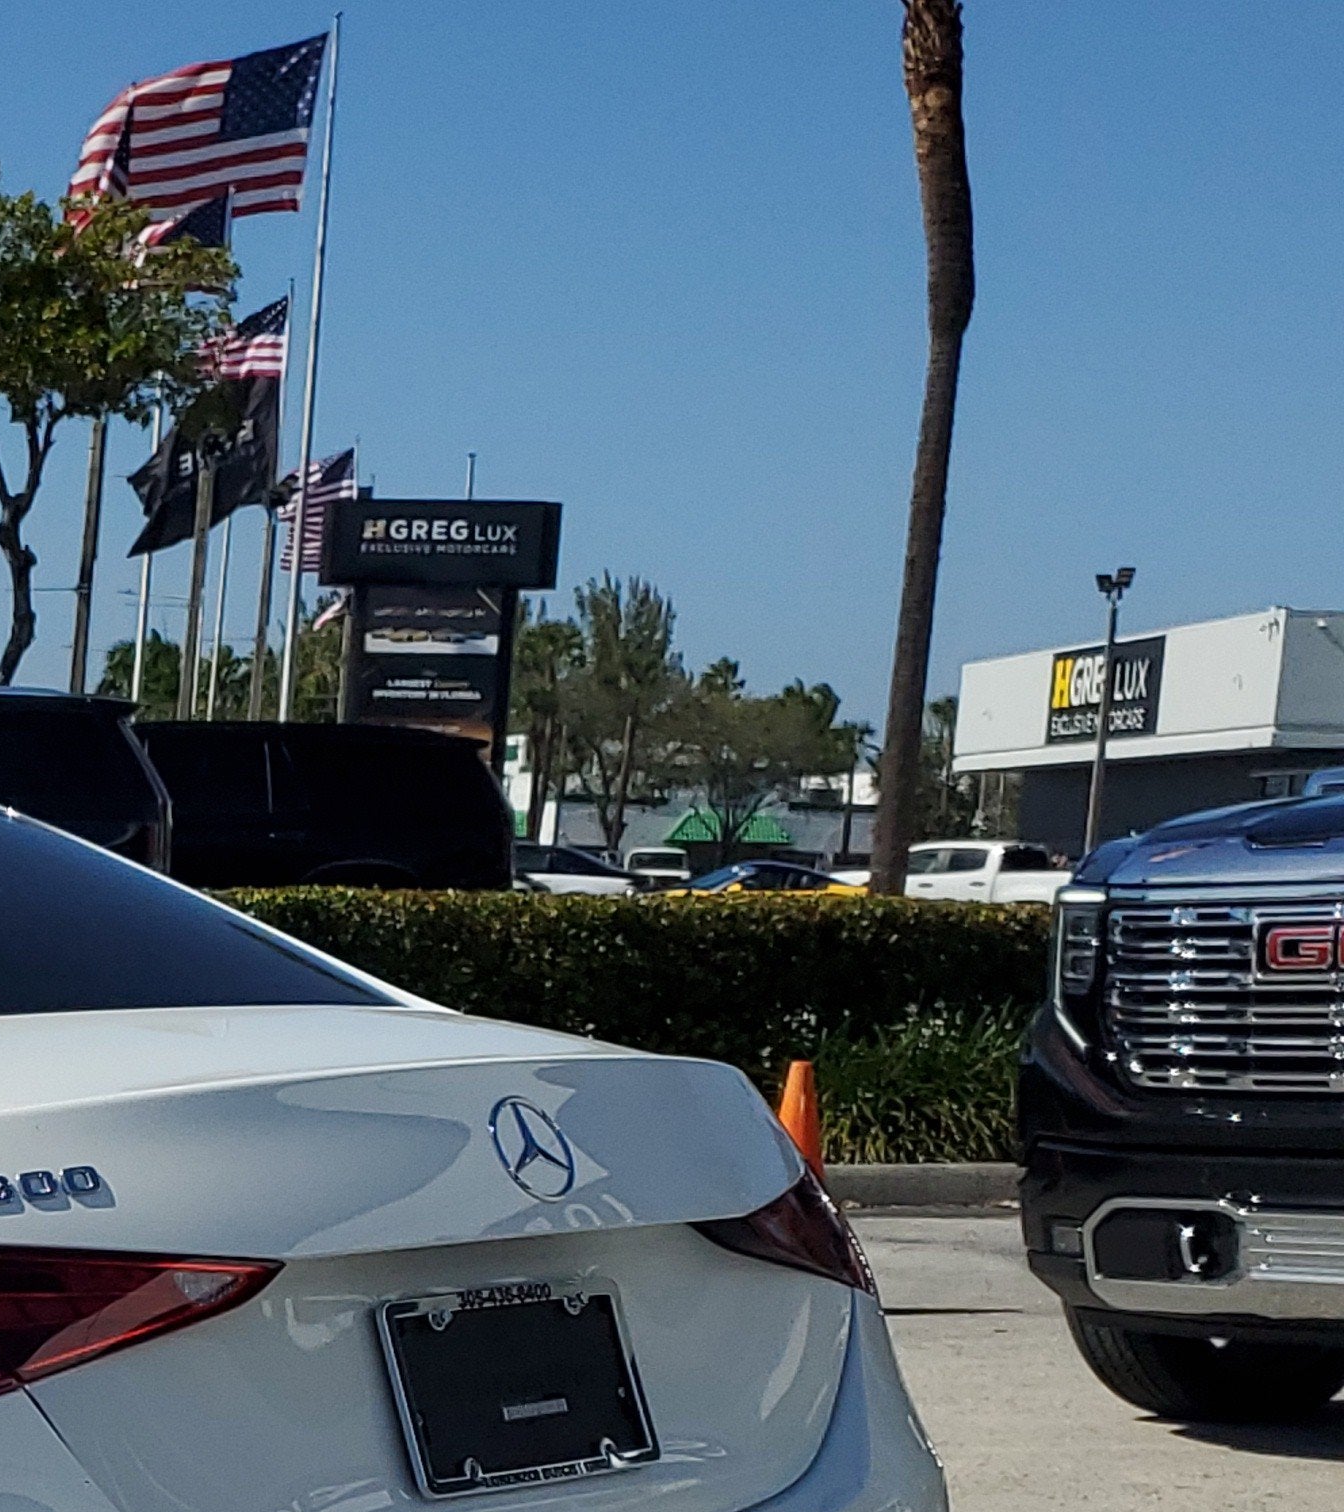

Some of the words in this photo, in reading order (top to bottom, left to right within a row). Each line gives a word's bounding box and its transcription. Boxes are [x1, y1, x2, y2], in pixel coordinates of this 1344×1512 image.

[475, 523, 518, 541] LUX
[1113, 657, 1151, 701] LUX
[1266, 926, 1344, 969] G
